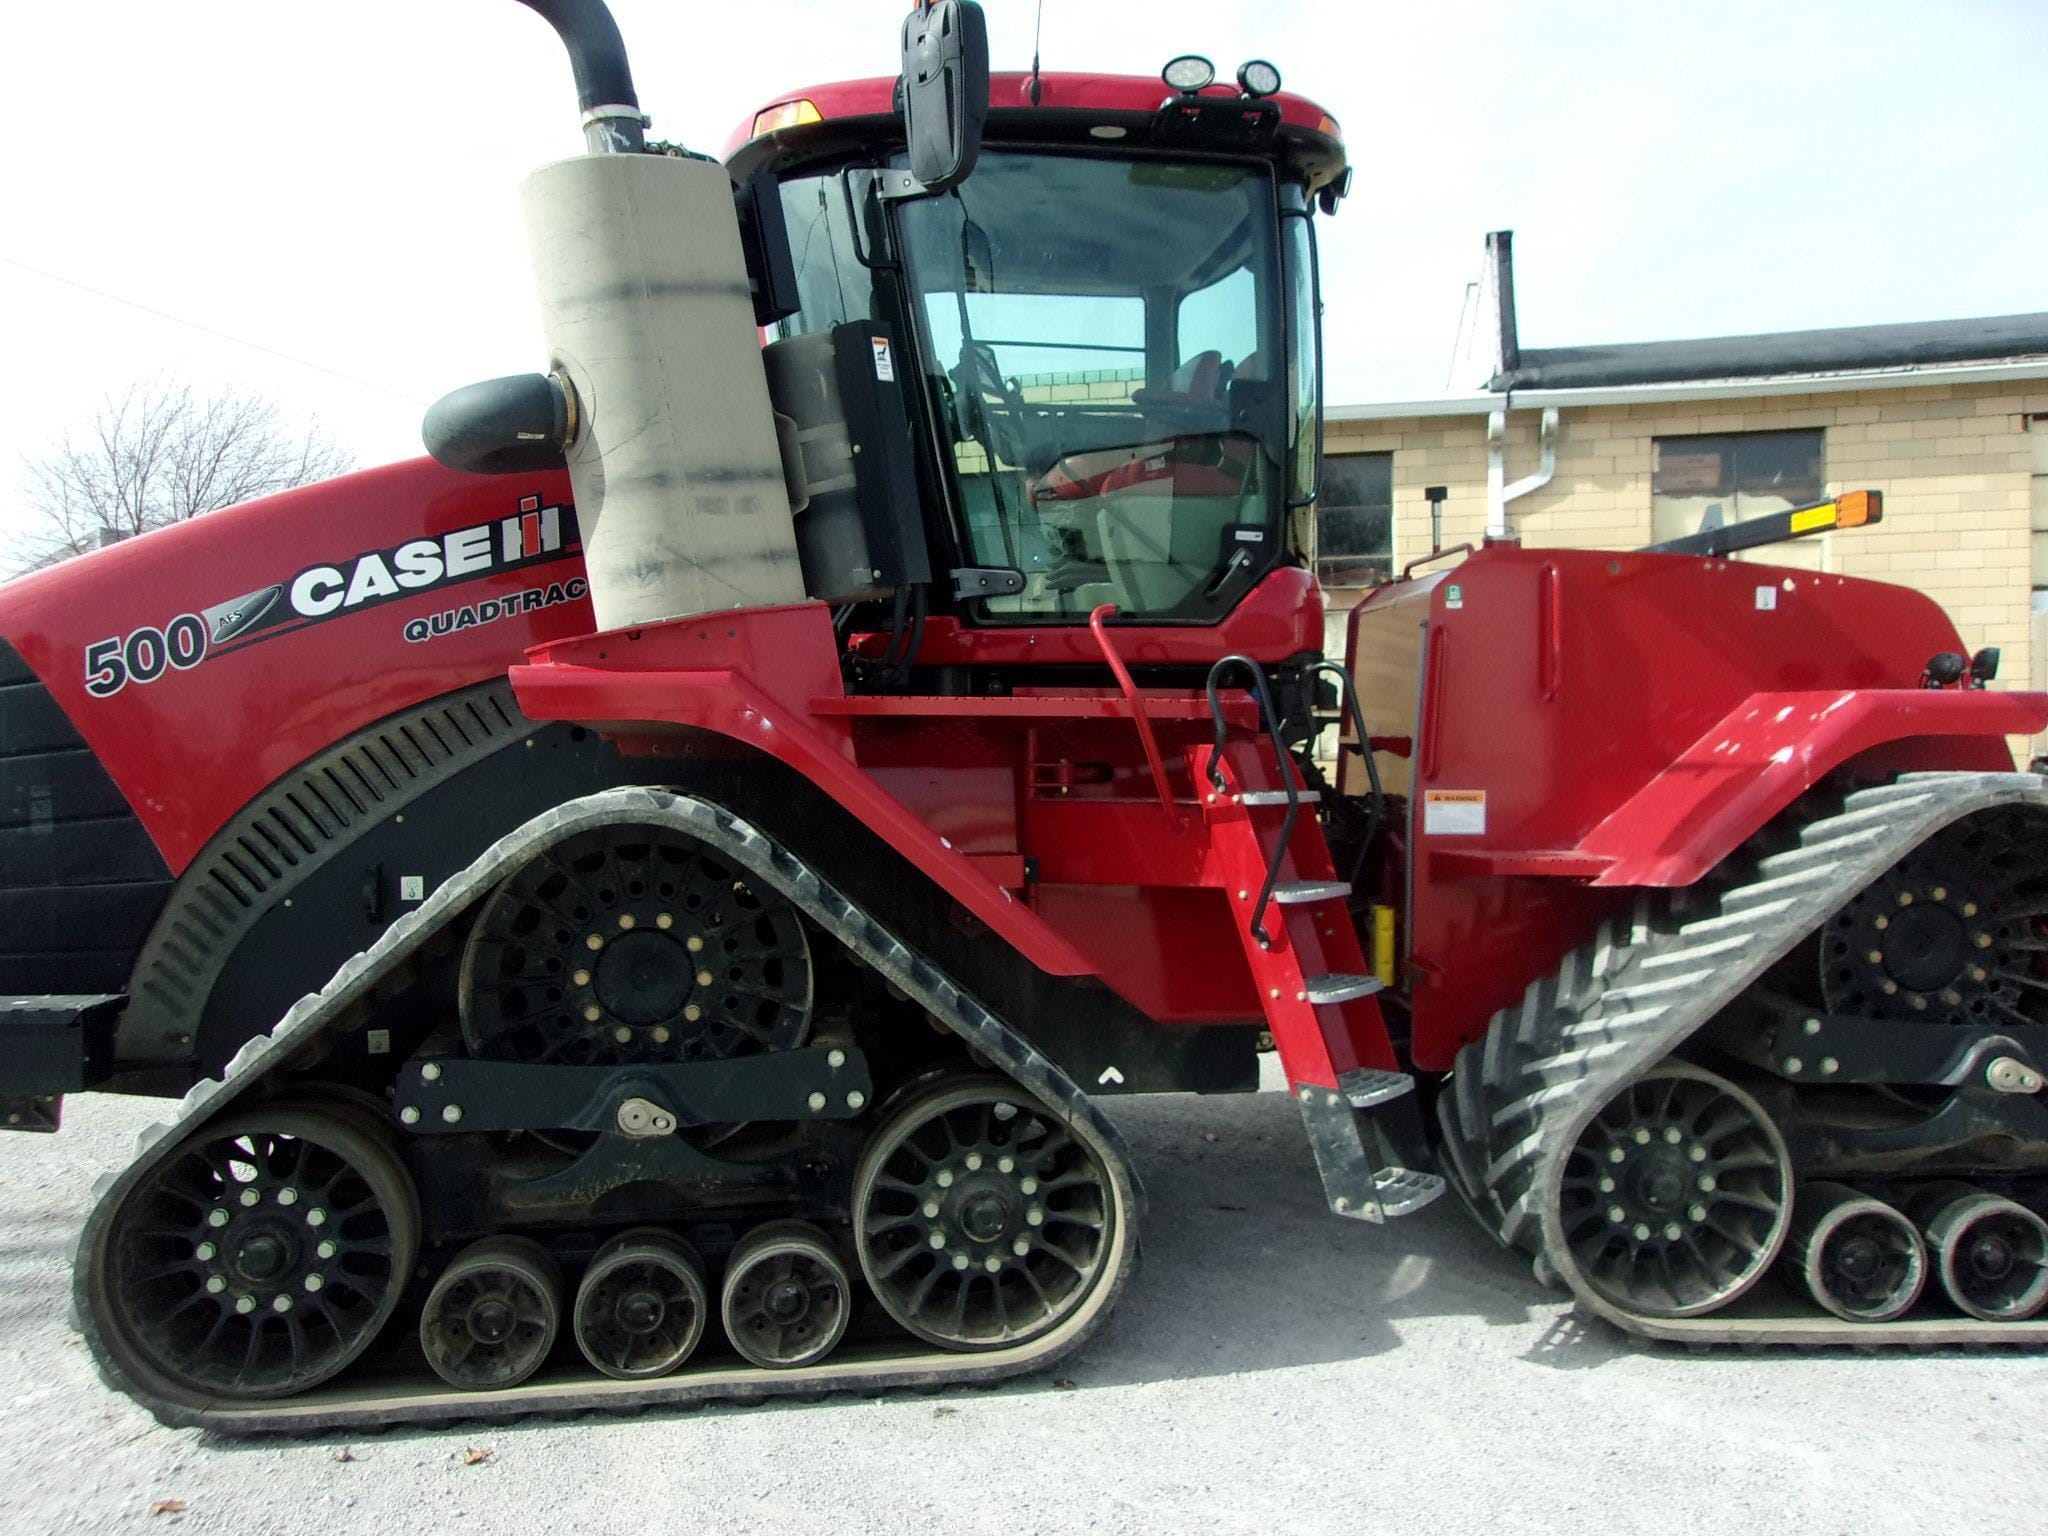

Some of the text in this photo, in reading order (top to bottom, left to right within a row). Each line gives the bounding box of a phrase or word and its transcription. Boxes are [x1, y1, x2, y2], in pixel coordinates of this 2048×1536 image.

[290, 525, 493, 617] CASE
[219, 609, 243, 628] AFS
[403, 577, 588, 643] QUADTRAC
[84, 612, 208, 698] 500
